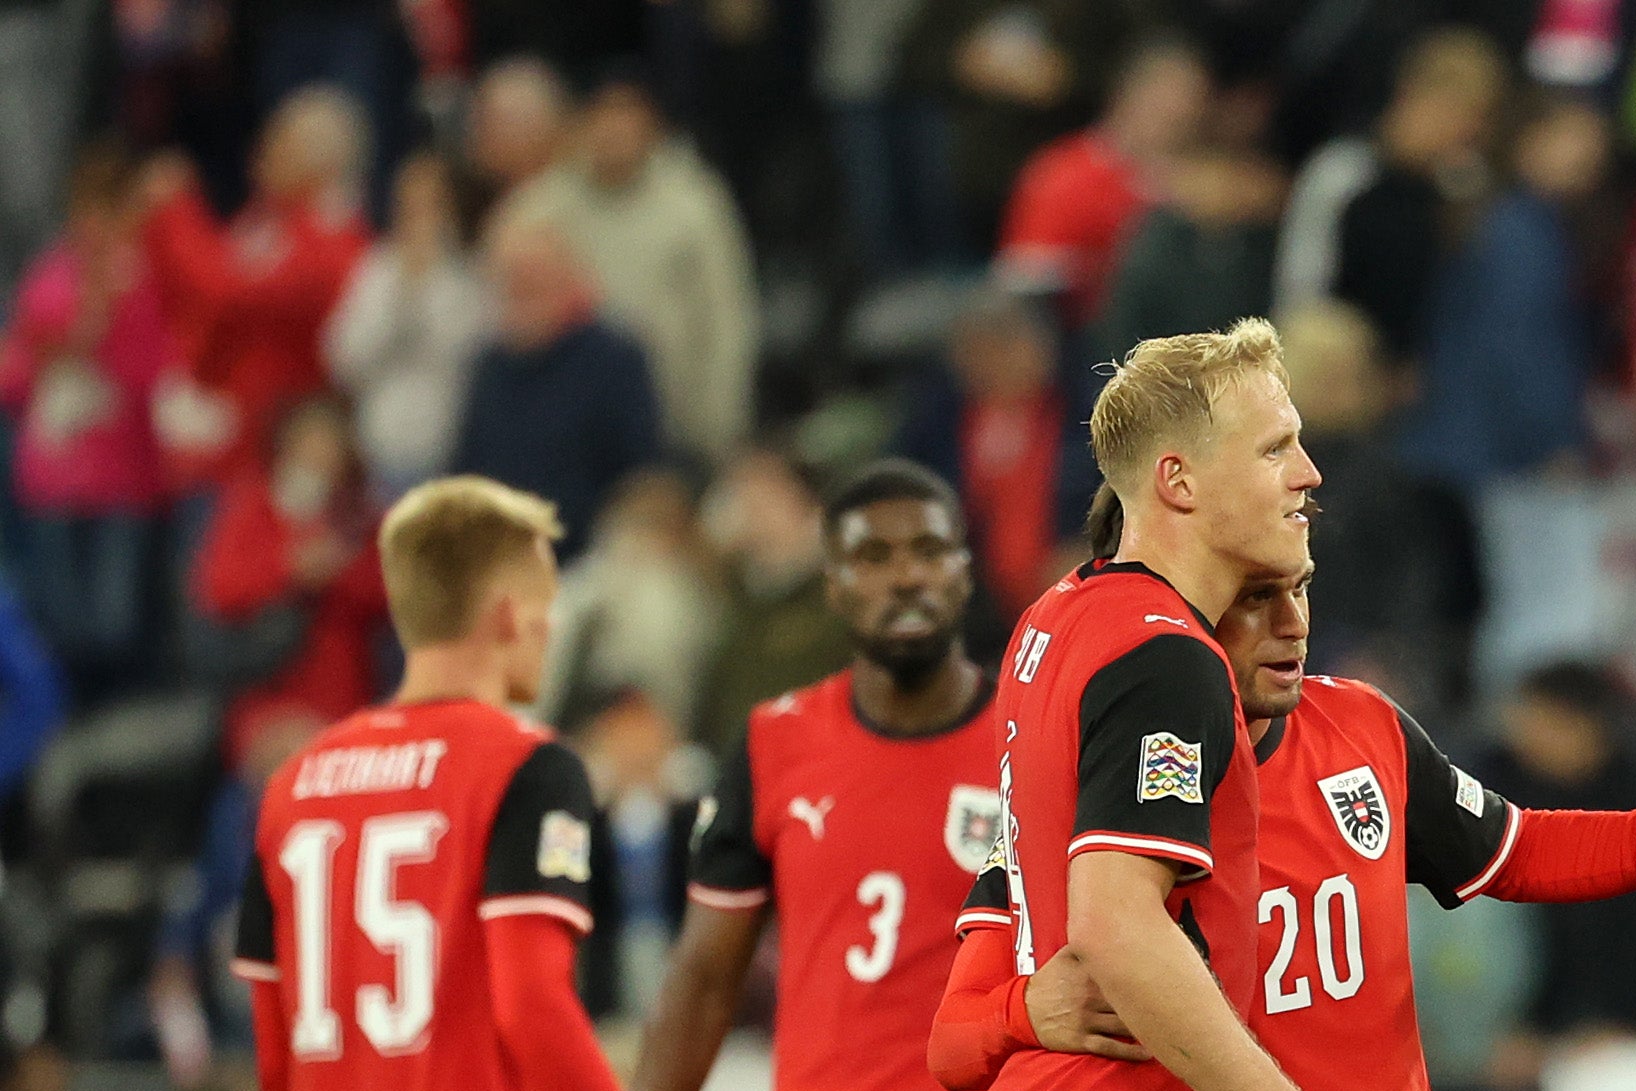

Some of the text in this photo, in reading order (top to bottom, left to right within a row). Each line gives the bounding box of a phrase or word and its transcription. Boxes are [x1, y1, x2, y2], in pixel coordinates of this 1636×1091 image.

[278, 811, 449, 1062] 15
[845, 870, 907, 982] 3
[1257, 873, 1365, 1014] 20
